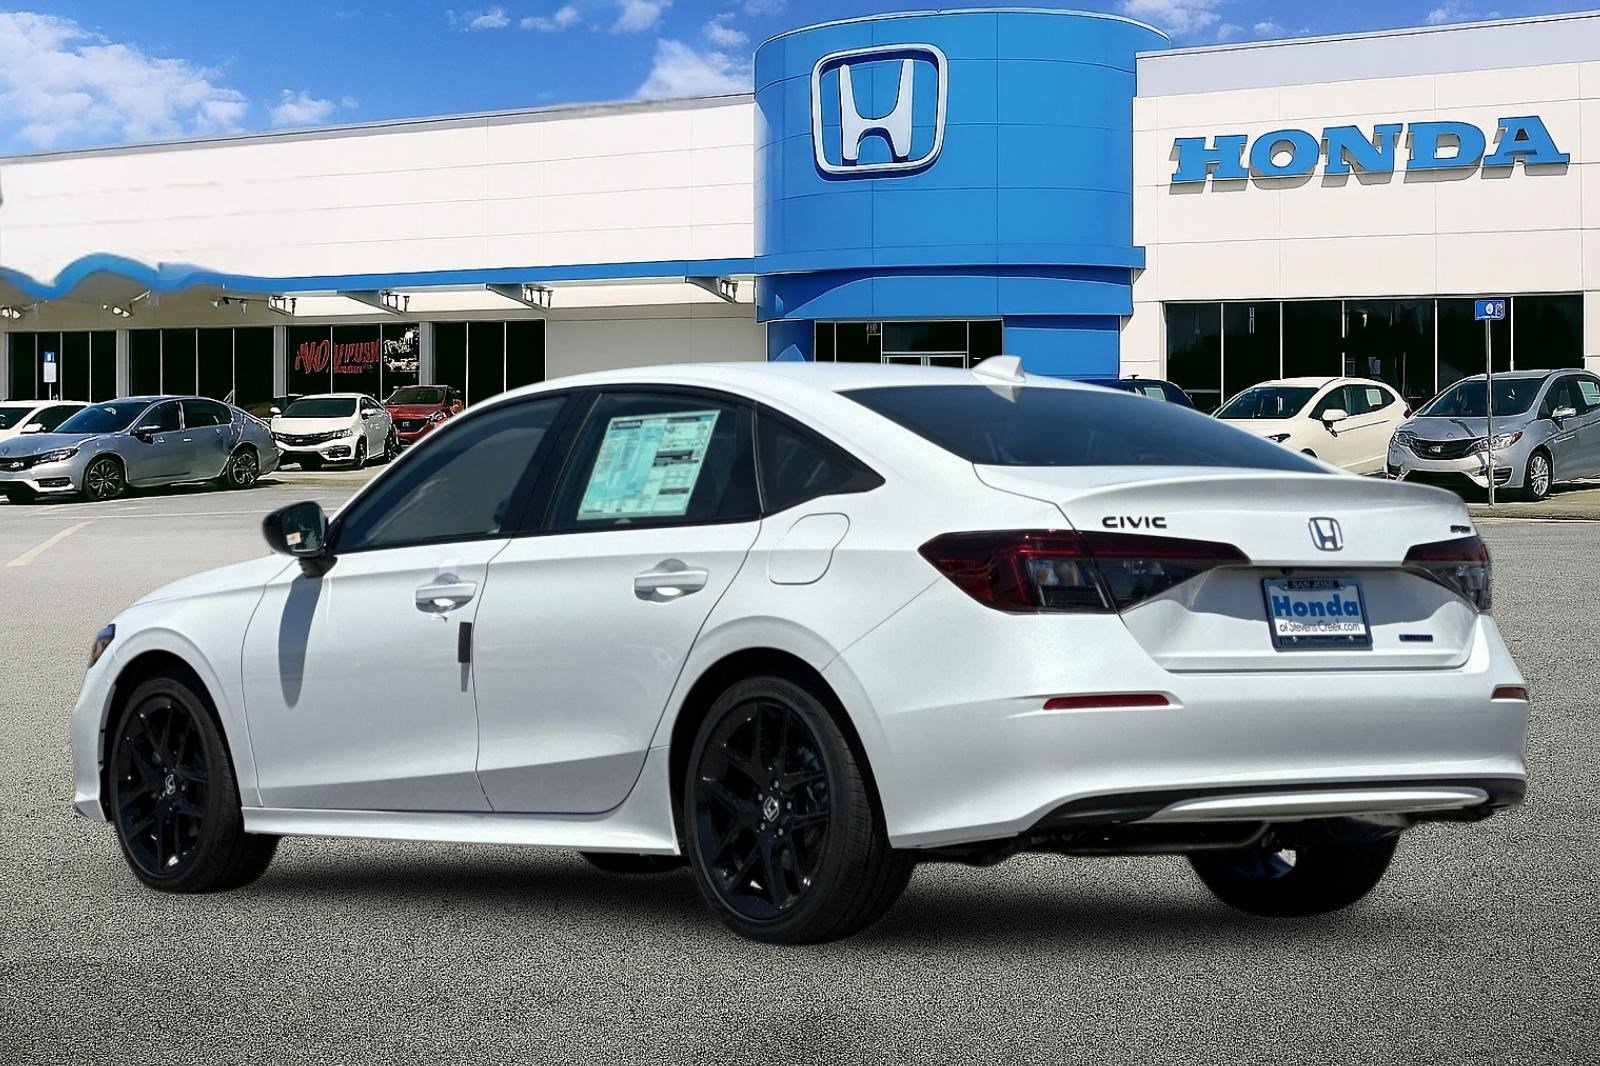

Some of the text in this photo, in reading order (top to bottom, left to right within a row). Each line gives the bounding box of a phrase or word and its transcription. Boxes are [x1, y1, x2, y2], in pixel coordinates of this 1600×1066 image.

[1170, 115, 1571, 184] HONDA
[1101, 516, 1168, 529] CIVIC
[1271, 593, 1360, 617] Honda
[1280, 623, 1288, 633] of
